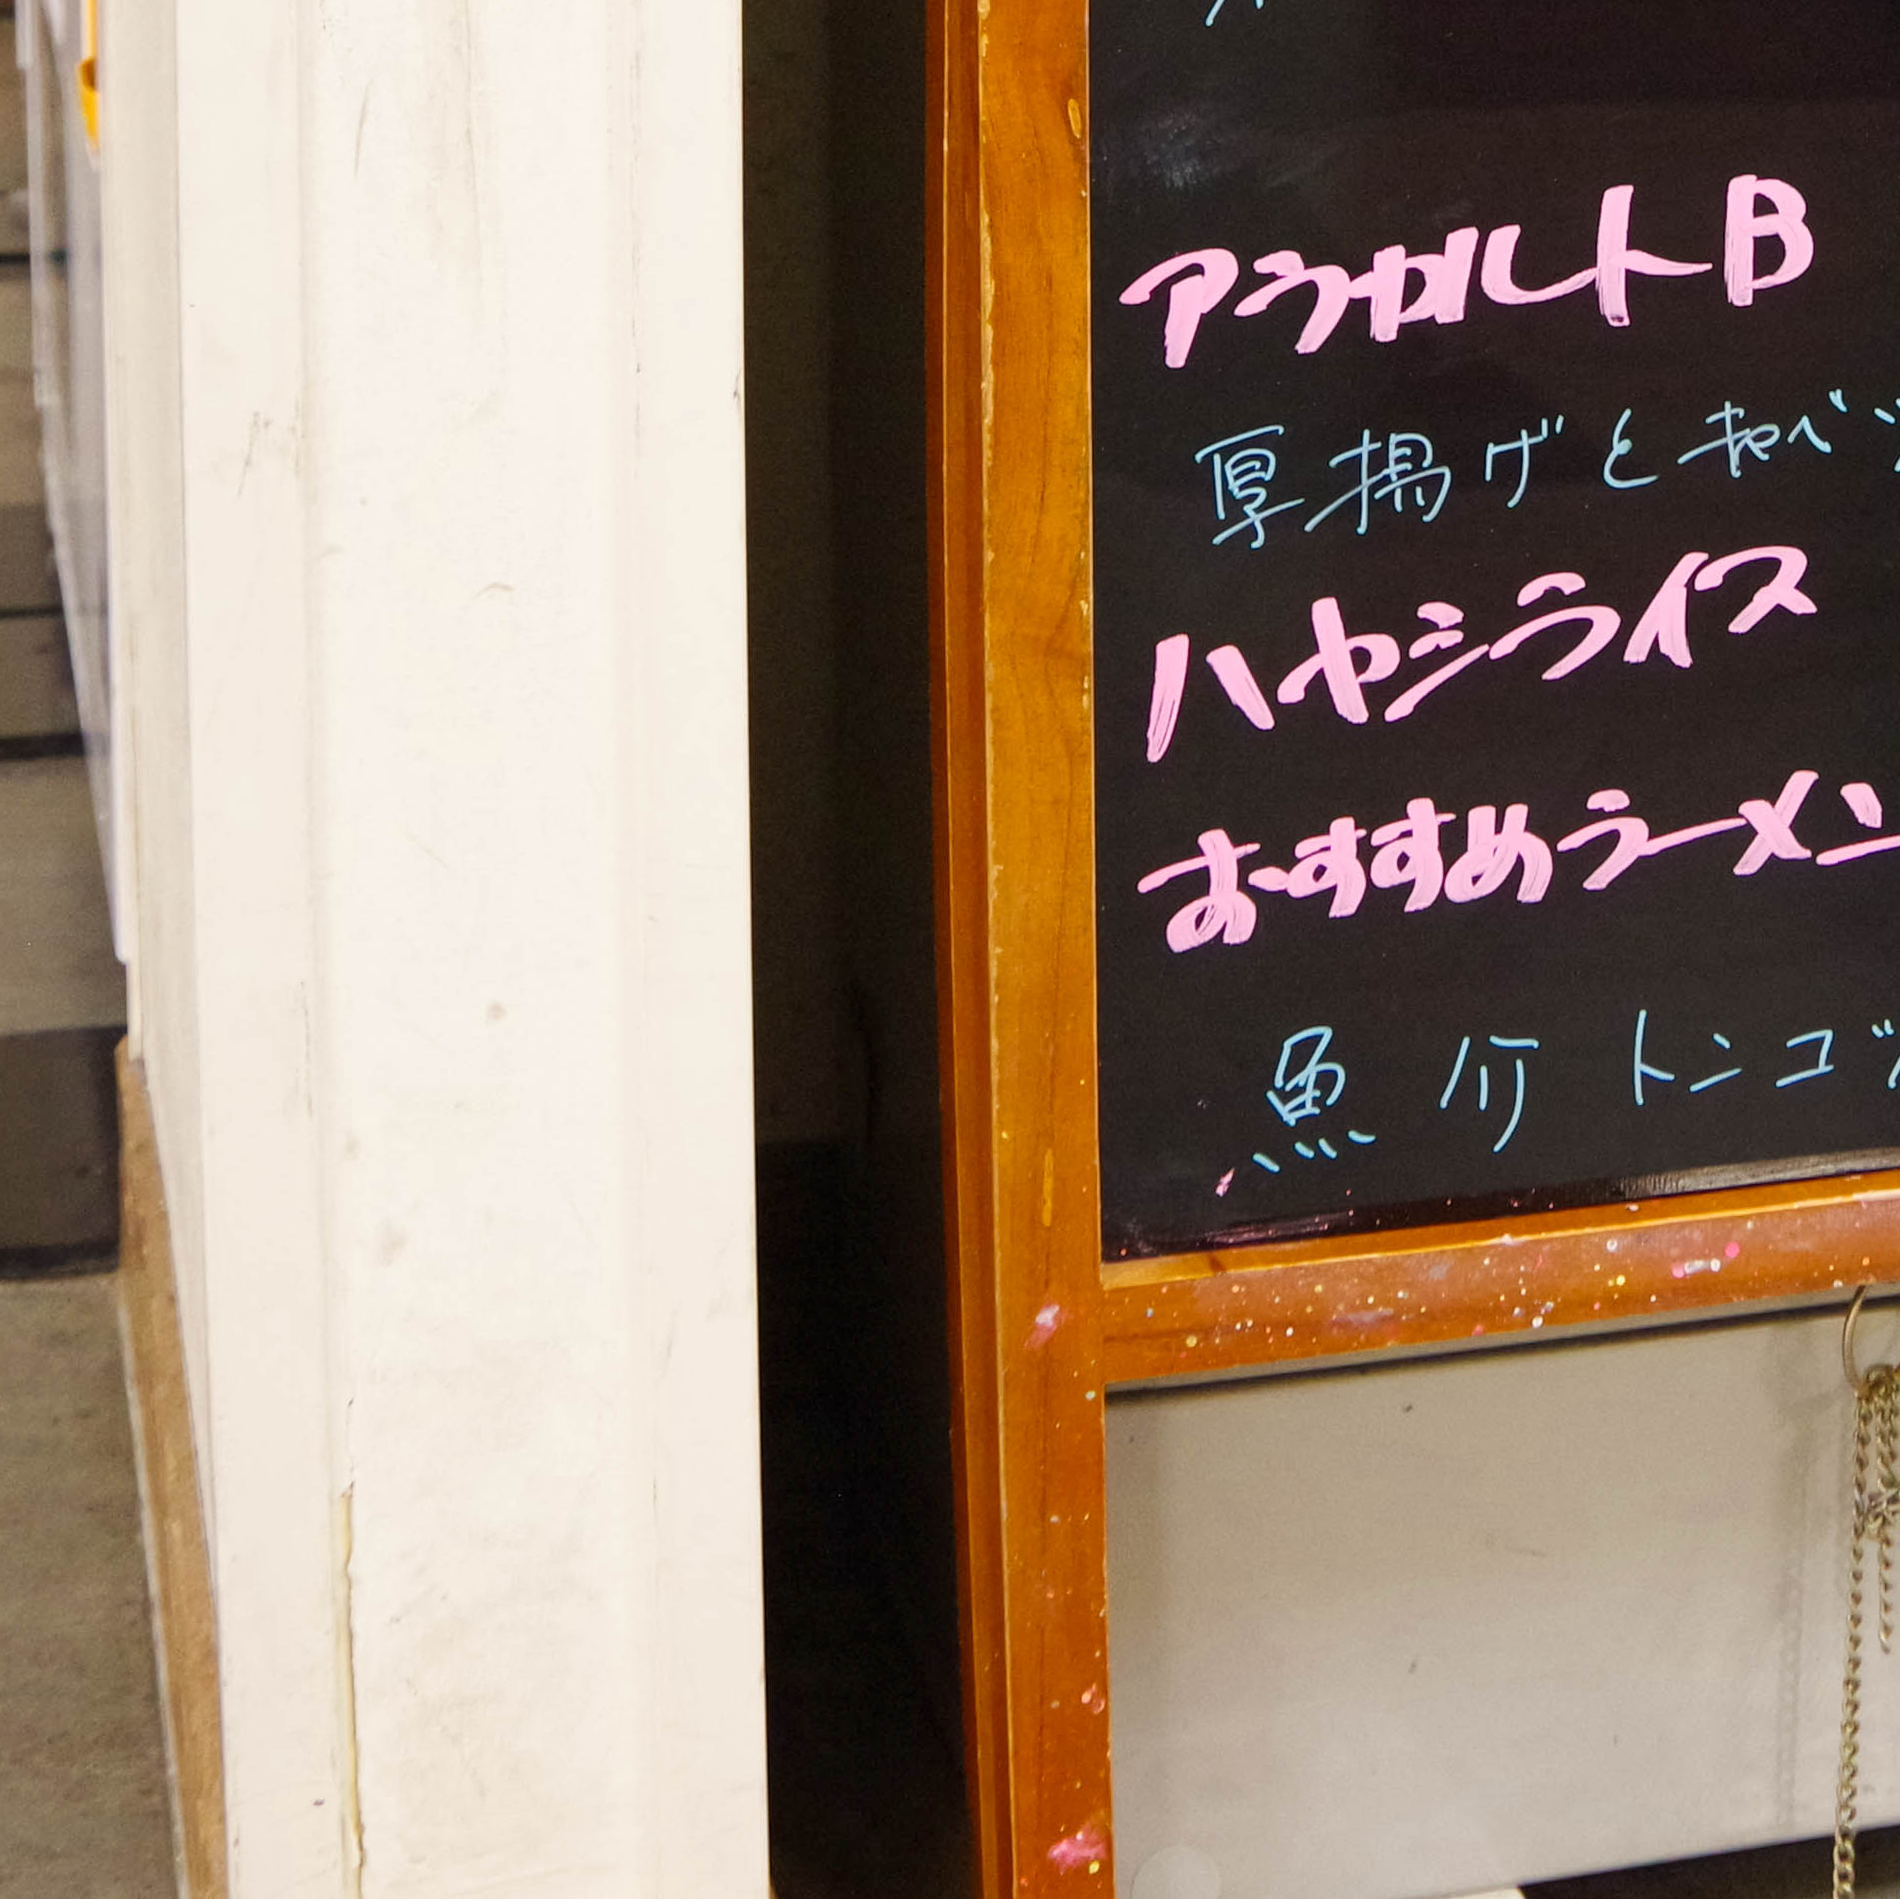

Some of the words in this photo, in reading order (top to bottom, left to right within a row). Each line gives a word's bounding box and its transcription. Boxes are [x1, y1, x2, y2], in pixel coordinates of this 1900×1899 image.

[1146, 545, 1818, 763] ハヤシライス
